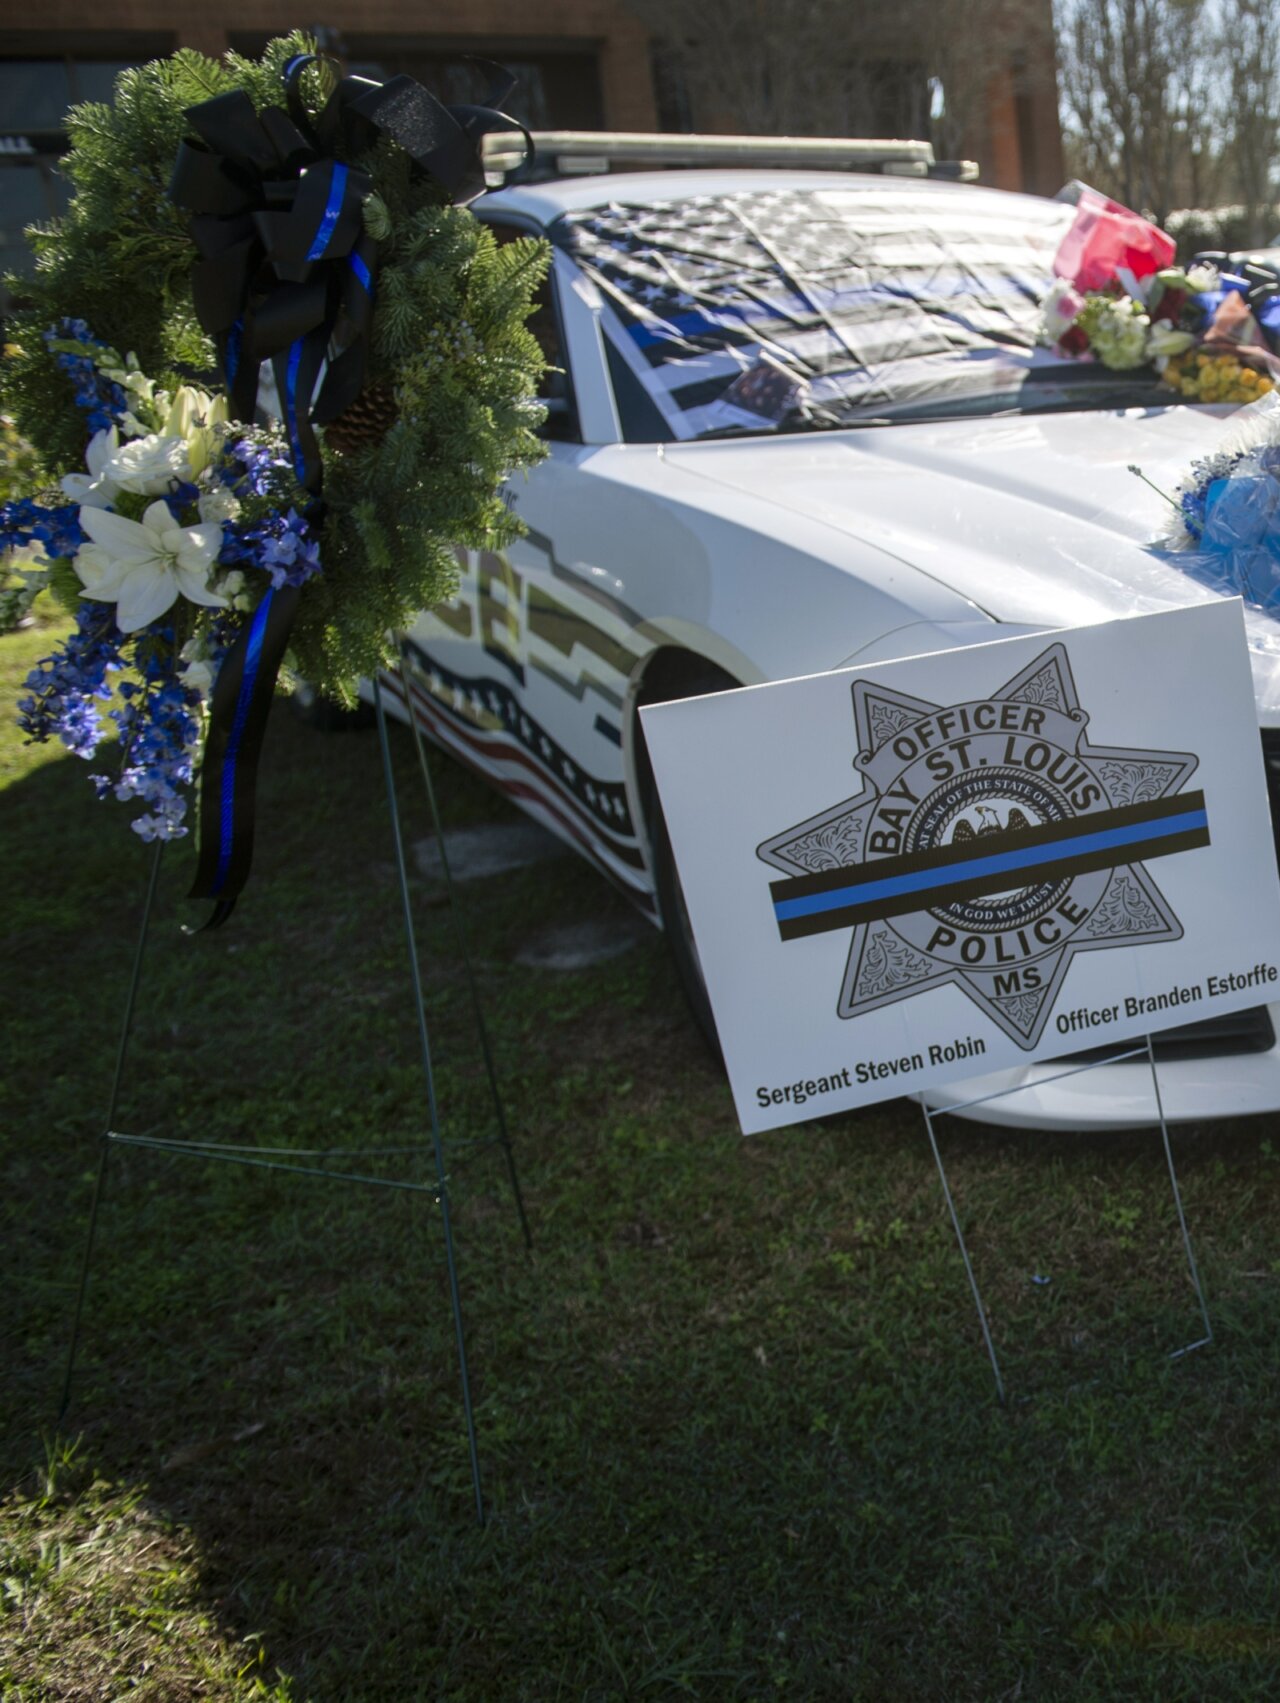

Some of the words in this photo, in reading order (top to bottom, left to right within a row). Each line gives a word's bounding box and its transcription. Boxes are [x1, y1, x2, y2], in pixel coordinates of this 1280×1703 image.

[893, 704, 1046, 761] OFFICER
[869, 778, 922, 855] BAY
[925, 739, 987, 782] ST.
[1003, 736, 1100, 811] LOUIS
[924, 804, 948, 831] SEAL
[946, 790, 964, 804] OF
[964, 780, 991, 794] THE
[994, 779, 1032, 796] STATE
[1033, 788, 1050, 804] OF
[926, 896, 1089, 963] POLICE
[949, 902, 962, 915] IN
[964, 909, 994, 920] GOD
[996, 908, 1017, 919] WE
[1017, 881, 1053, 911] TRUST
[993, 967, 1042, 996] MS
[1056, 1004, 1119, 1034] Officer
[1124, 984, 1202, 1018] Branden
[1207, 963, 1278, 997] Estorffe
[756, 1067, 851, 1107] Sergeant
[855, 1053, 924, 1084] Steven
[928, 1036, 986, 1066] Robin
